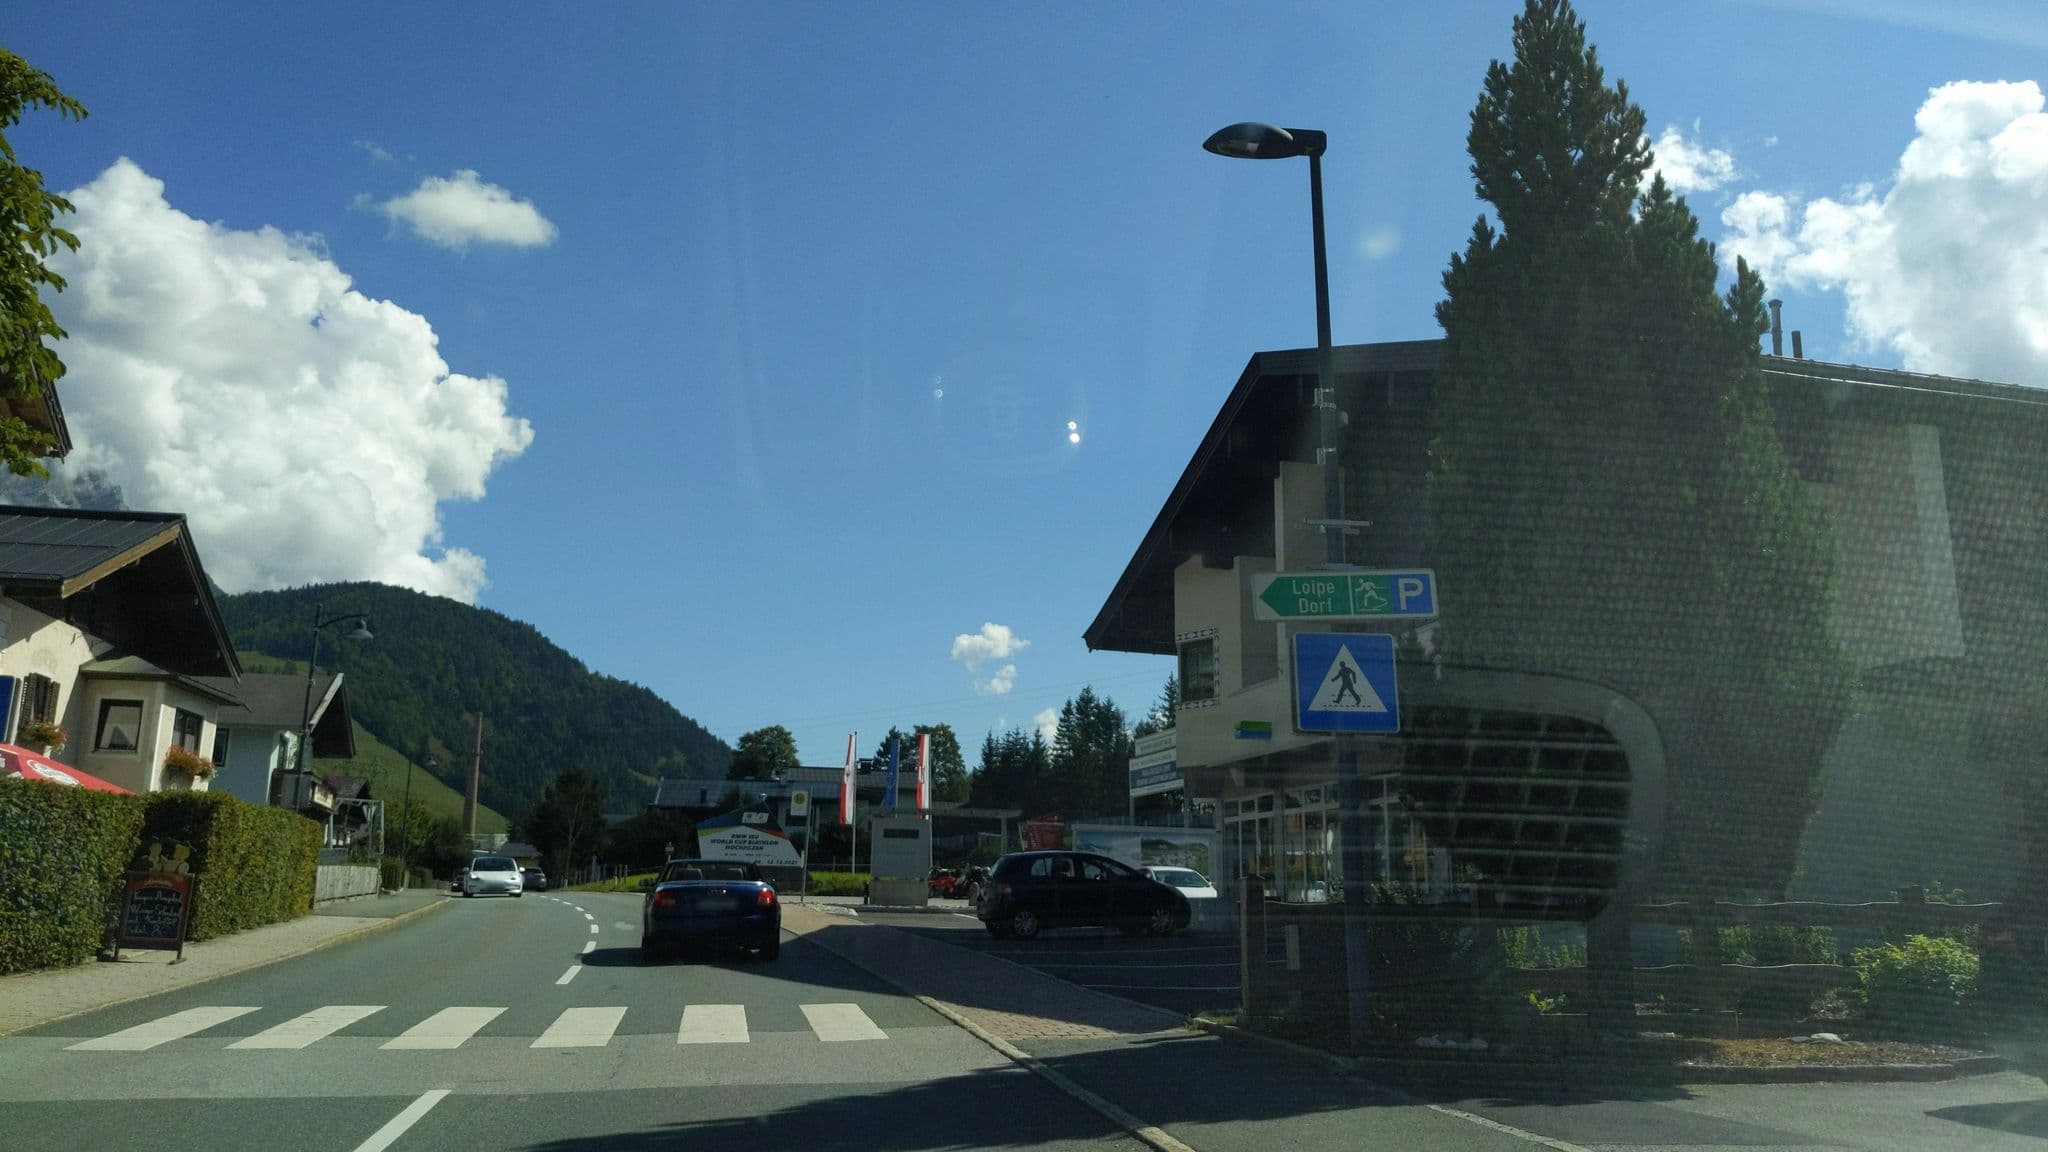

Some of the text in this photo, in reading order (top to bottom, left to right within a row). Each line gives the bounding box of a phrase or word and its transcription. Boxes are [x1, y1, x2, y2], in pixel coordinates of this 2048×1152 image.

[1291, 579, 1336, 597] Loipe
[1397, 577, 1425, 611] P
[1299, 597, 1333, 613] Dorf
